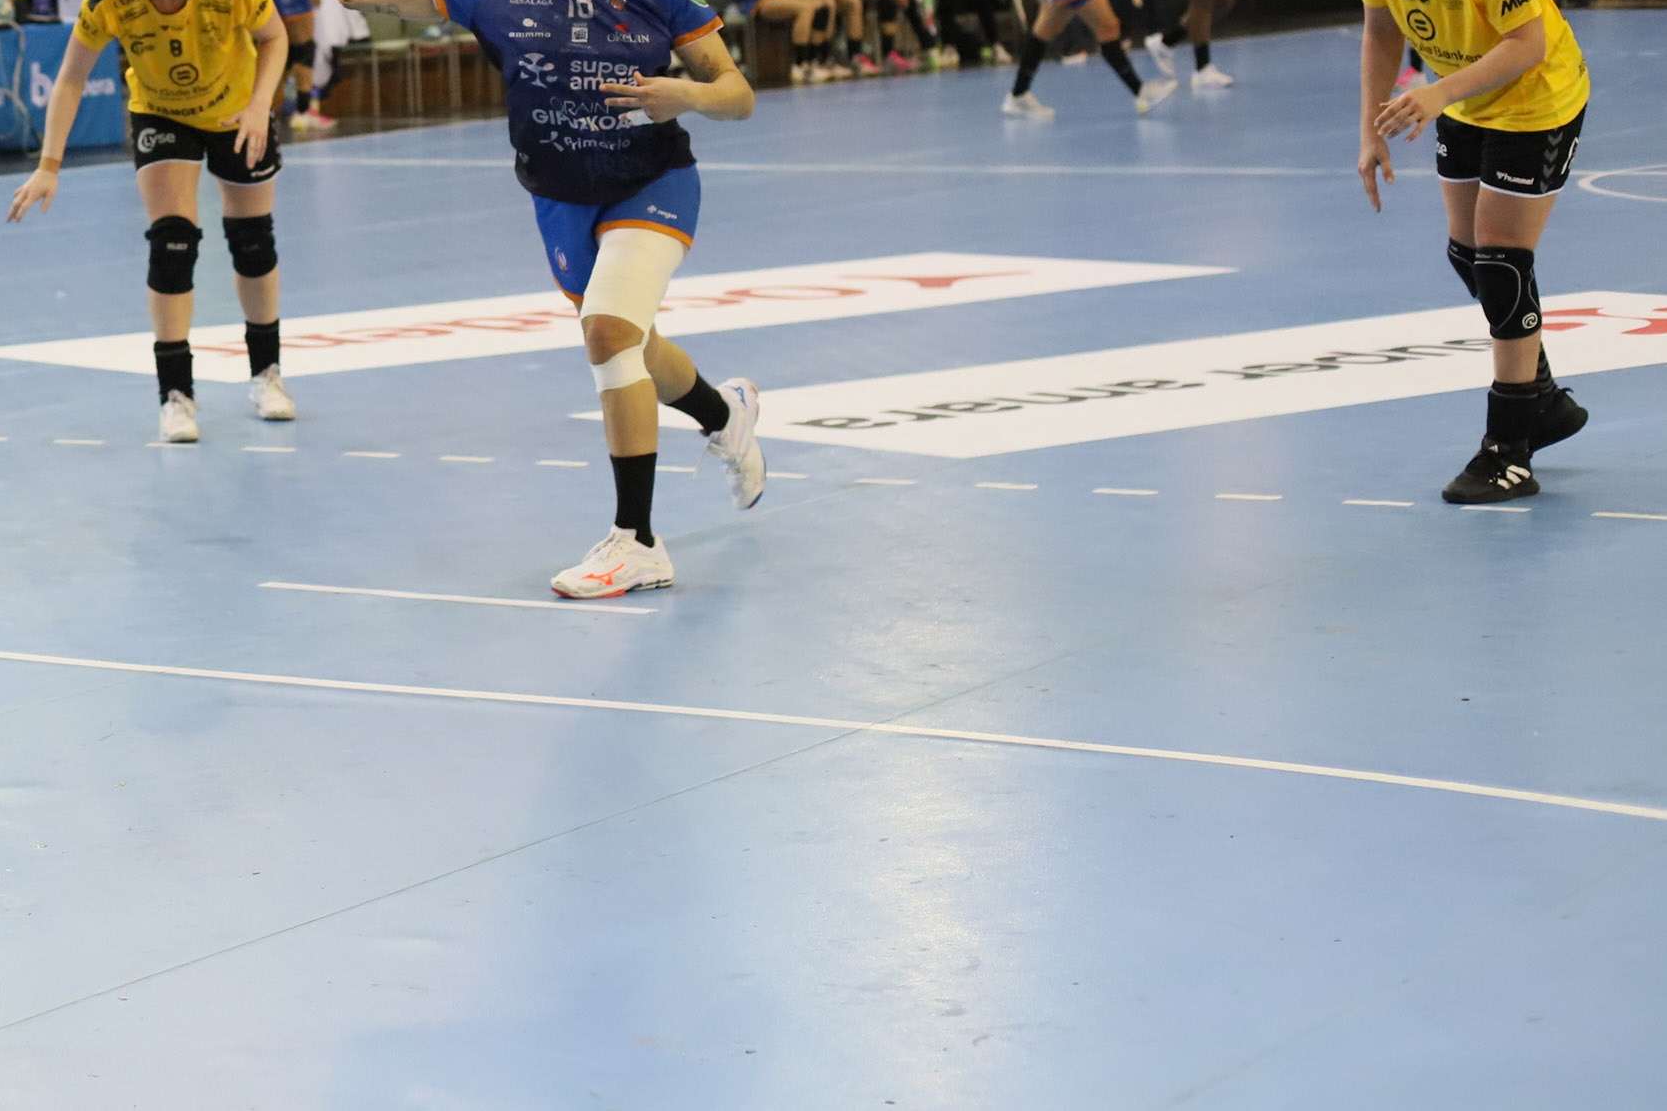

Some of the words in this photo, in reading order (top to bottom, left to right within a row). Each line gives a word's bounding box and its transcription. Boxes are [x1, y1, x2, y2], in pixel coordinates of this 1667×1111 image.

[169, 39, 183, 58] 8
[569, 59, 639, 79] super
[787, 376, 1205, 431] amara
